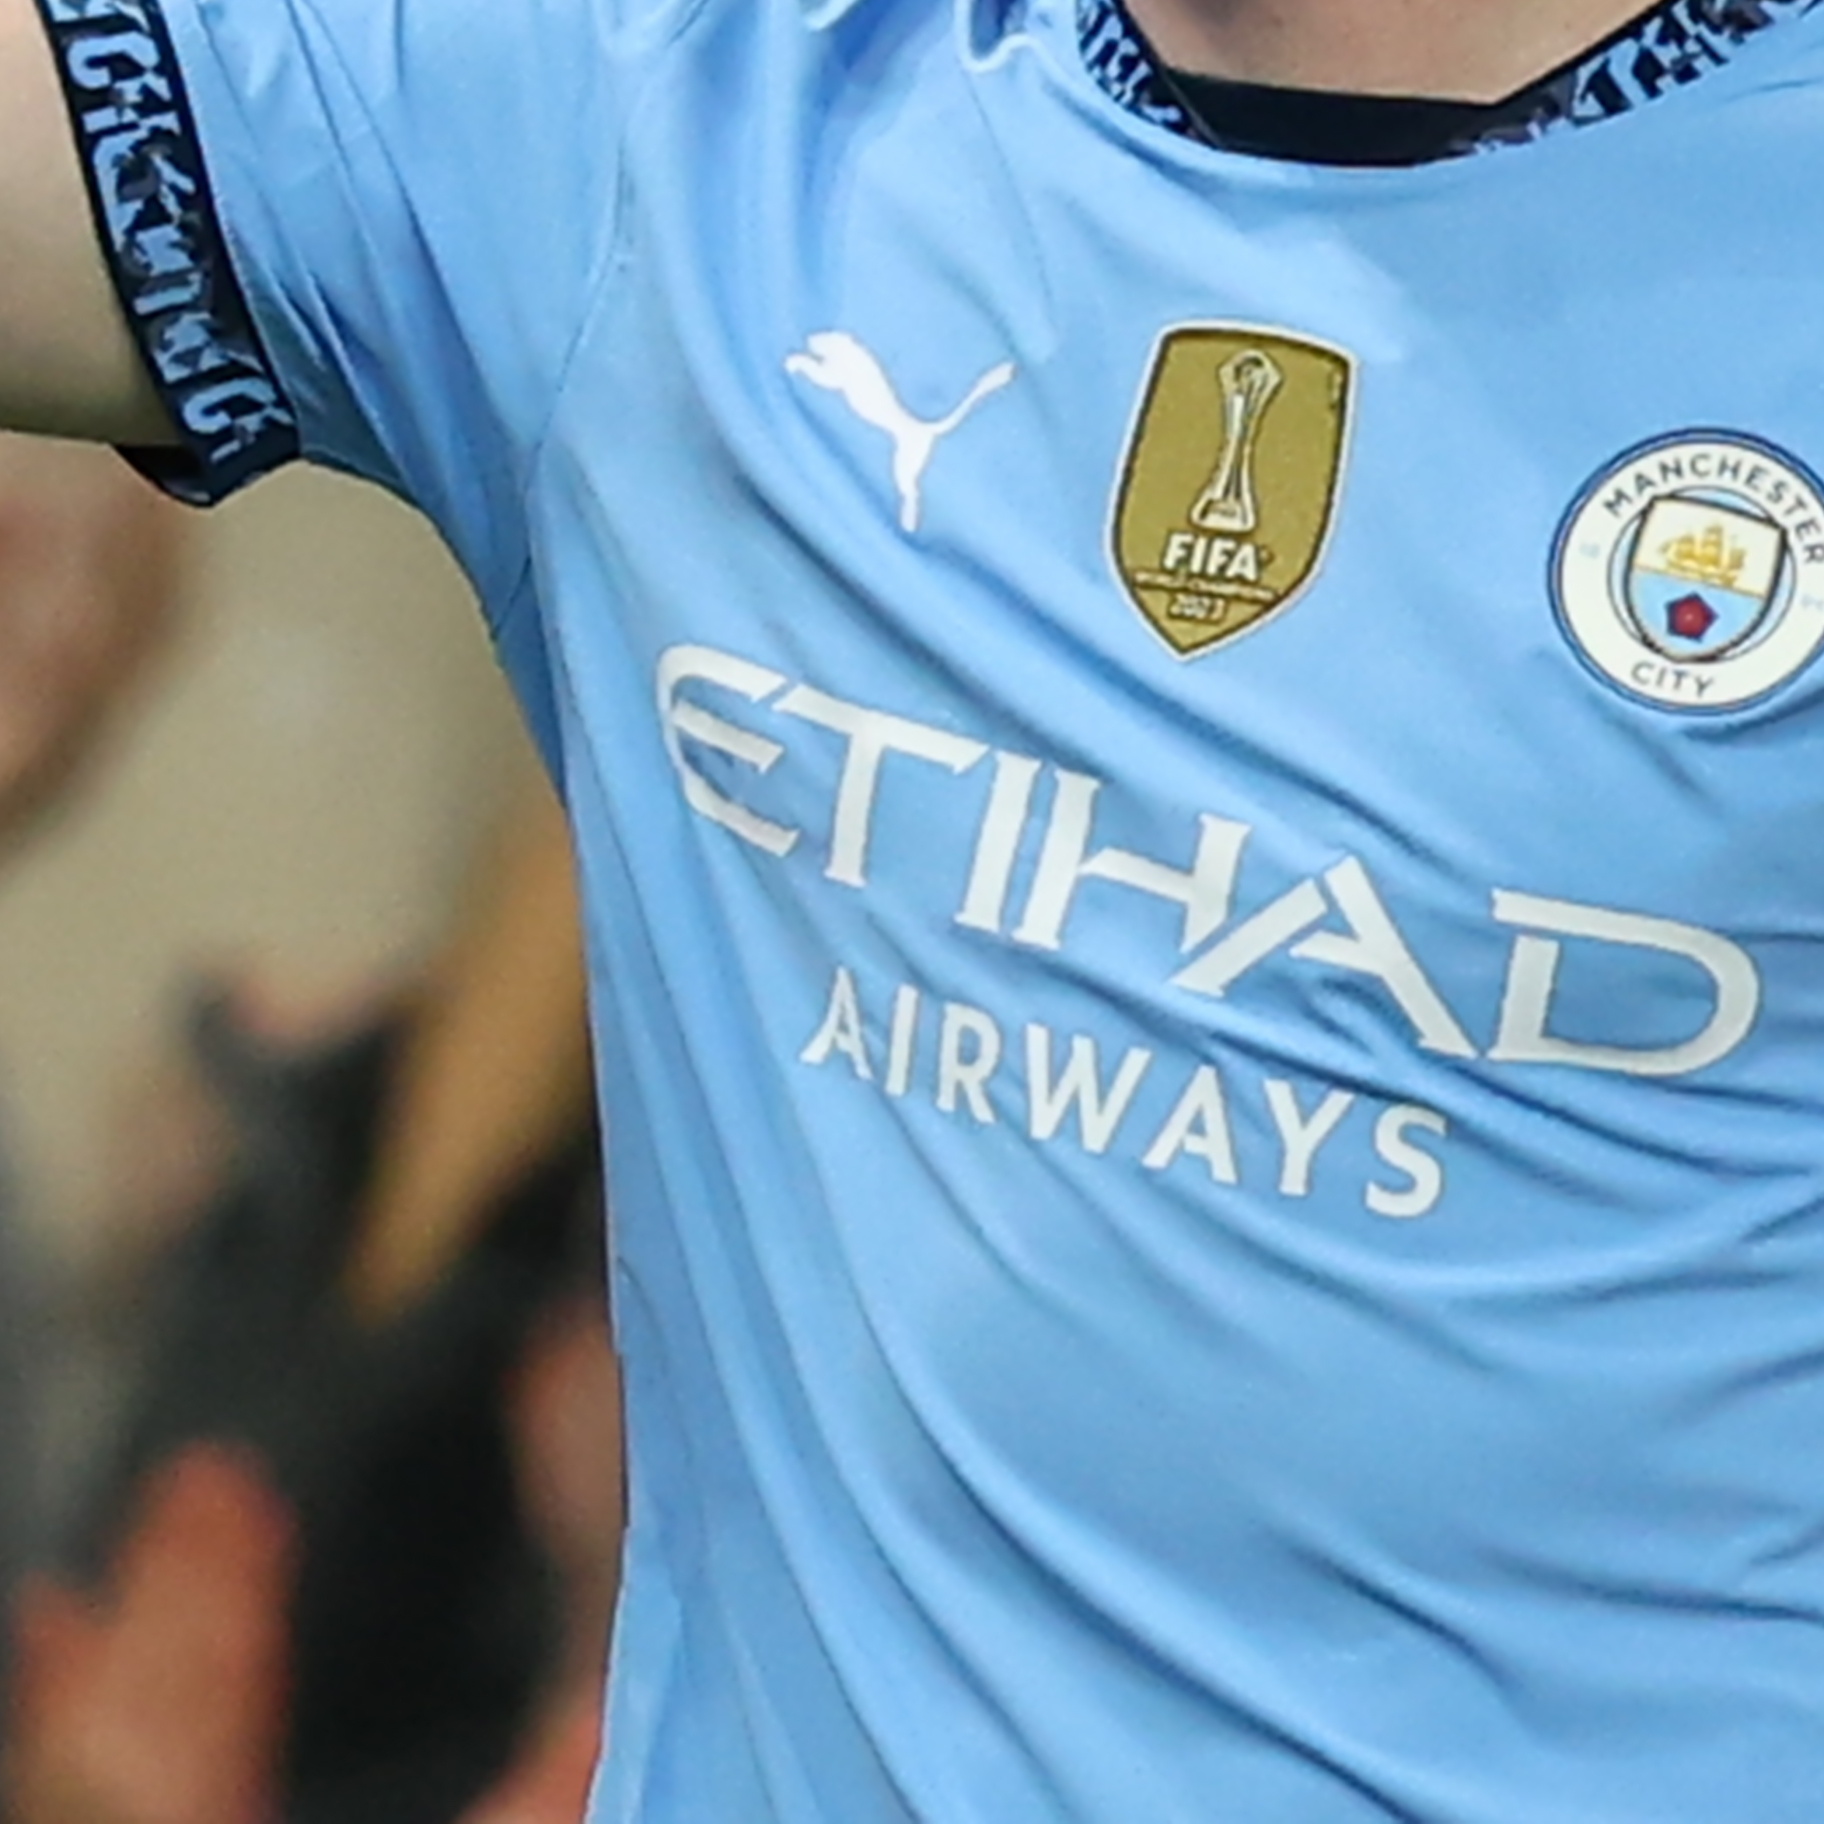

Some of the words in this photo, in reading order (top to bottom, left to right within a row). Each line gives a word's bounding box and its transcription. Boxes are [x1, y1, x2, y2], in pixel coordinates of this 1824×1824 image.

[1163, 533, 1258, 582] FIFA
[1630, 660, 1714, 699] CITY
[654, 642, 1762, 1078] ETIHAD
[798, 965, 1449, 1220] AIRWAYS
